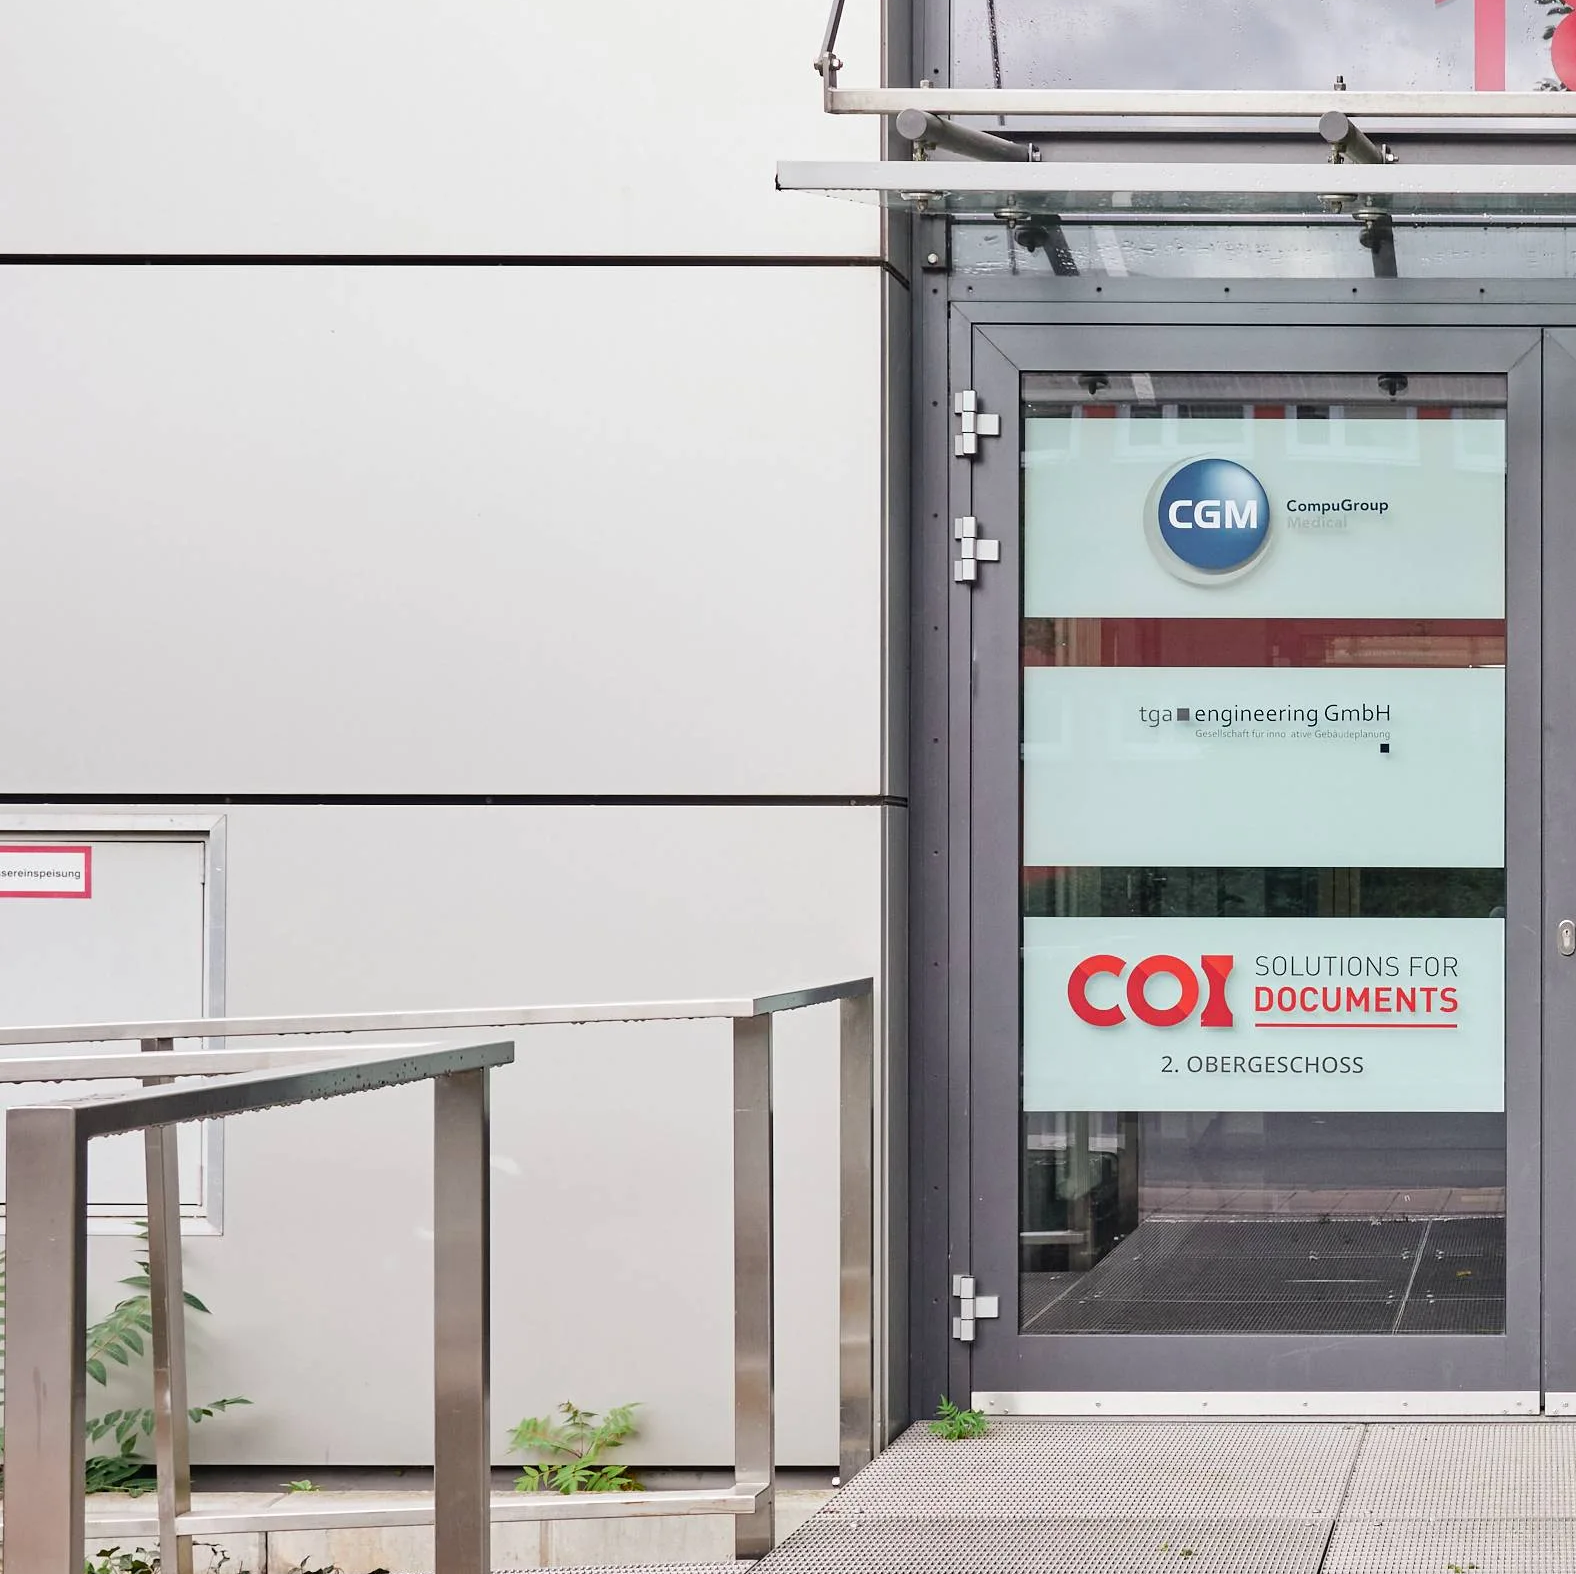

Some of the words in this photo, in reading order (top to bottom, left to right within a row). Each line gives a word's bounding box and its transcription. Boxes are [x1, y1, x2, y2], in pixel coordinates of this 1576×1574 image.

[1168, 499, 1258, 529] CGM
[1286, 498, 1389, 515] CompuGroup
[1287, 516, 1348, 529] Medical
[1139, 706, 1172, 727] tga
[1195, 704, 1318, 727] engineering
[1324, 703, 1390, 722] GmbH
[1195, 729, 1250, 738] Gesellschaft
[0, 869, 81, 880] sereinspeisung
[1067, 954, 1234, 1028] COI
[1255, 955, 1400, 977] SOLUTIONS
[1409, 955, 1459, 977] FOR
[1255, 986, 1459, 1013] DOCUMENTS
[1161, 1056, 1180, 1074] 2.
[1187, 1056, 1364, 1074] OBERGESCHOSS
